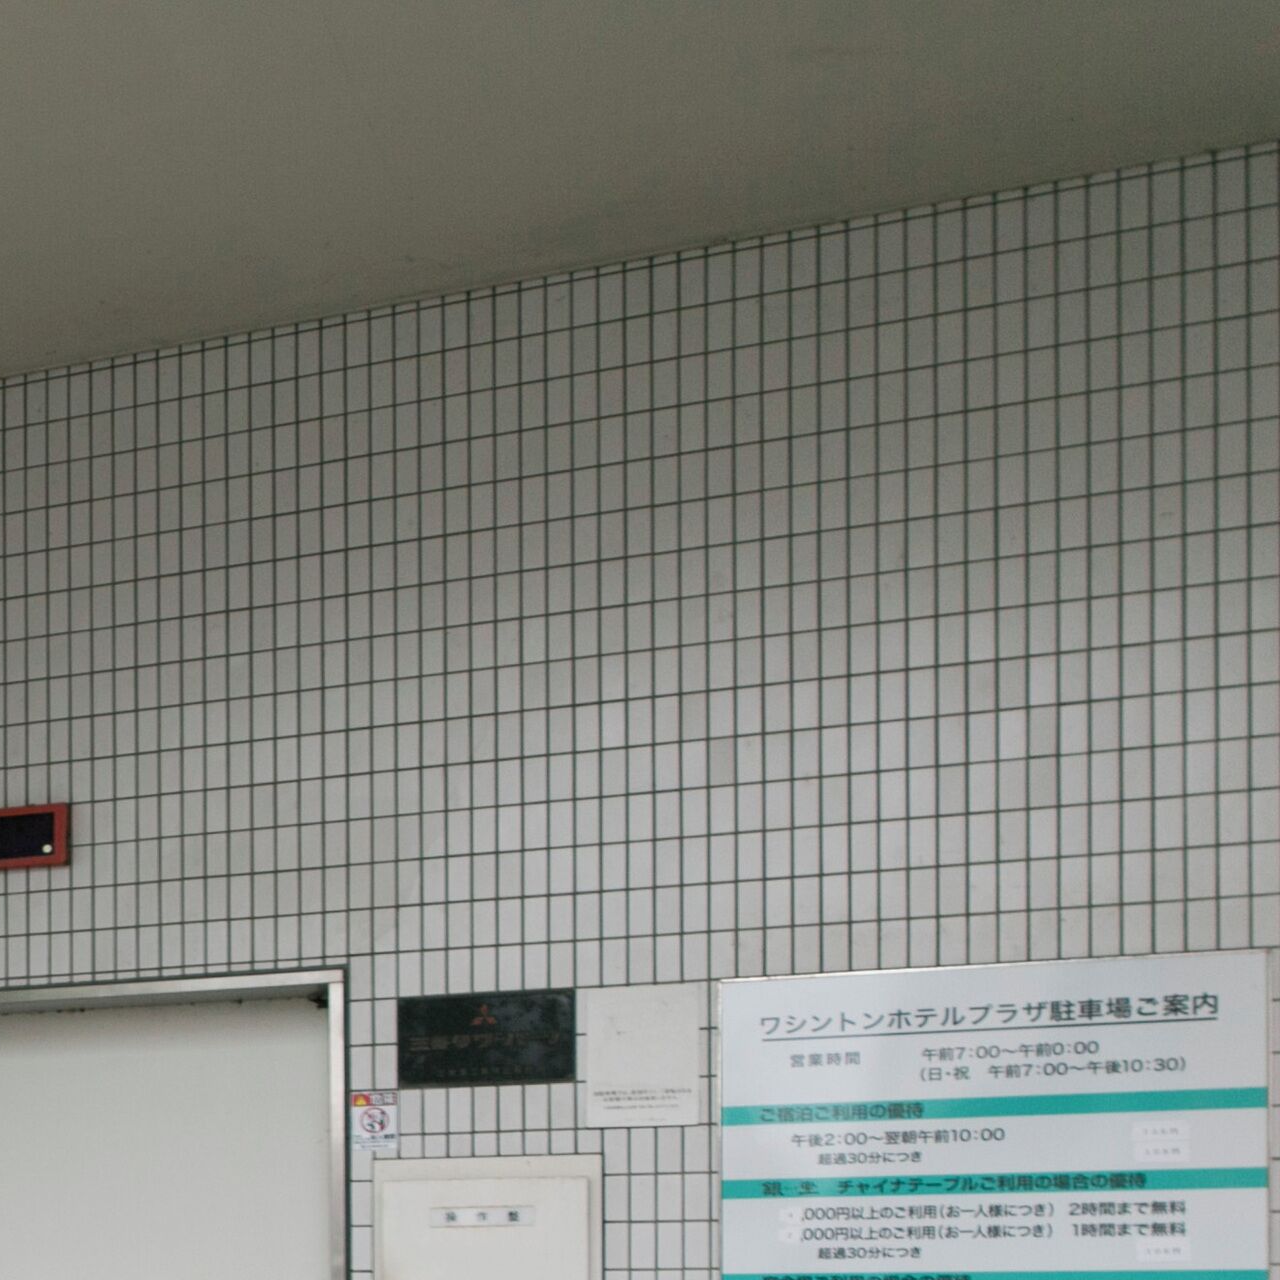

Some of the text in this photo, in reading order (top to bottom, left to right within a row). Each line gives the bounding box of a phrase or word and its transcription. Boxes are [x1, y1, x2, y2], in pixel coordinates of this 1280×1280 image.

[760, 992, 1219, 1035] ワシントンホテルプラザ駐車場ご案内
[790, 1051, 861, 1068] 営業時間
[760, 1102, 924, 1122] ご宿泊ご利用の優待
[818, 1151, 923, 1166] 超過30分につき
[838, 1173, 1147, 1194] チャイナテーブルご利用の場合の優待
[1068, 1201, 1187, 1216] 2時間まで無料
[1072, 1222, 1187, 1238] 1時間まで無料
[818, 1246, 922, 1259] 超過30分につき
